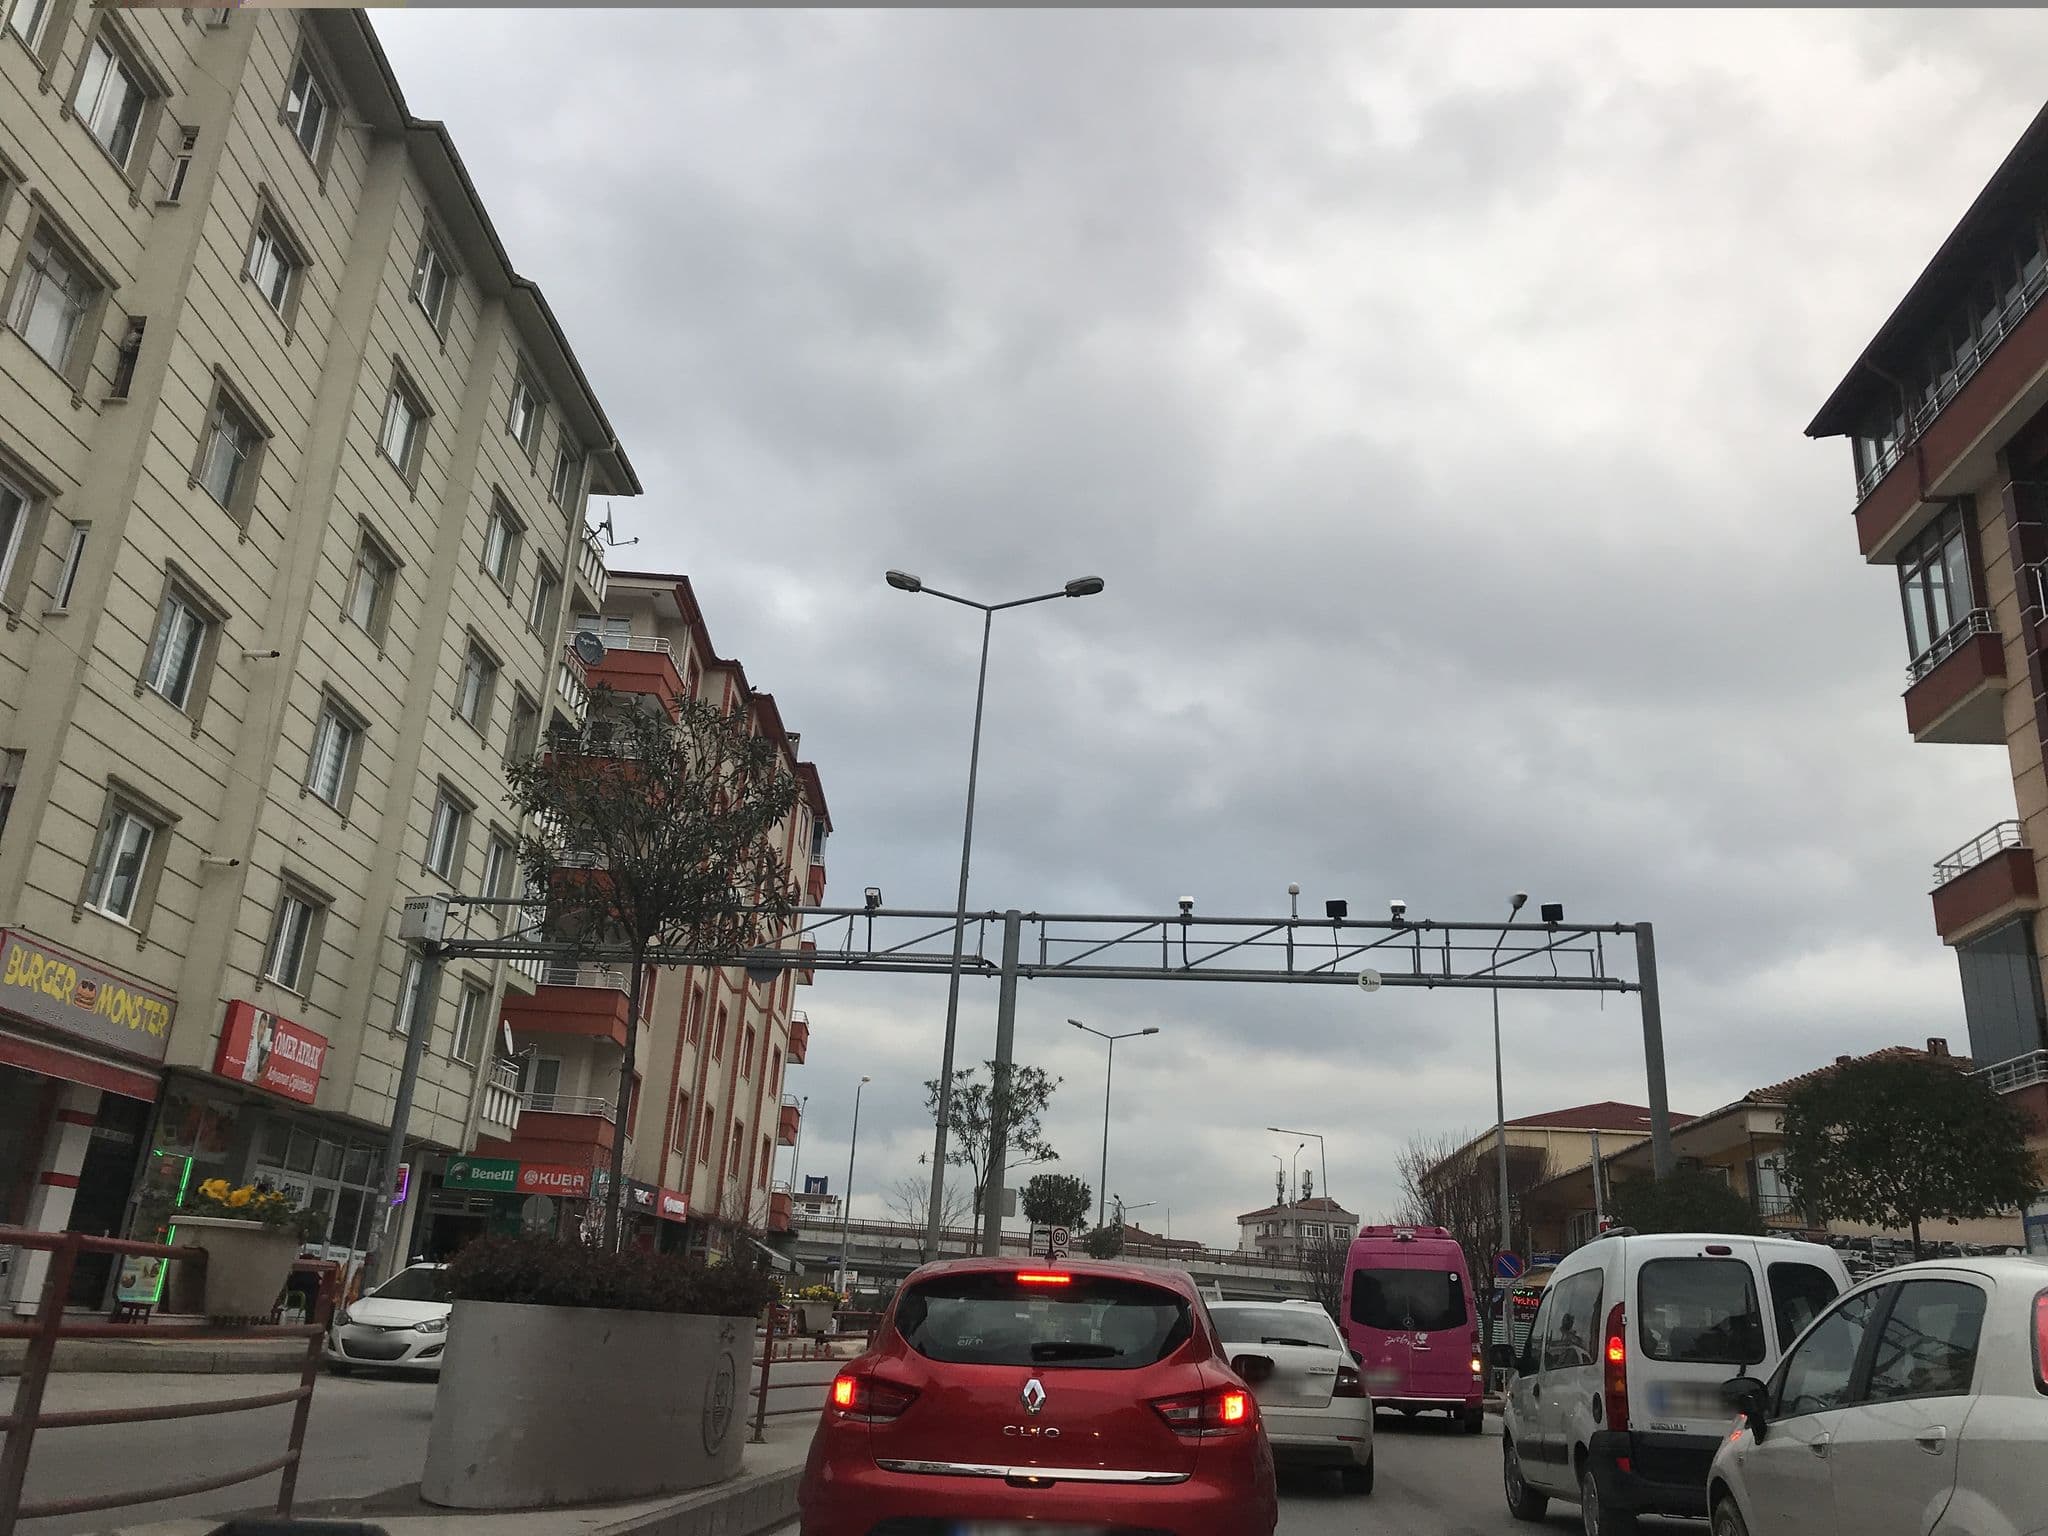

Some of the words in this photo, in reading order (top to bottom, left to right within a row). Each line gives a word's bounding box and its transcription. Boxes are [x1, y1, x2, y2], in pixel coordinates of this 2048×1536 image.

[4, 944, 77, 1006] BURGER
[93, 983, 169, 1038] MONSTER
[274, 1025, 298, 1060] ÖMER
[471, 1168, 514, 1181] Benelli
[539, 1173, 584, 1186] KUBA
[1055, 1232, 1066, 1242] 60
[1003, 1425, 1060, 1438] CLIO
